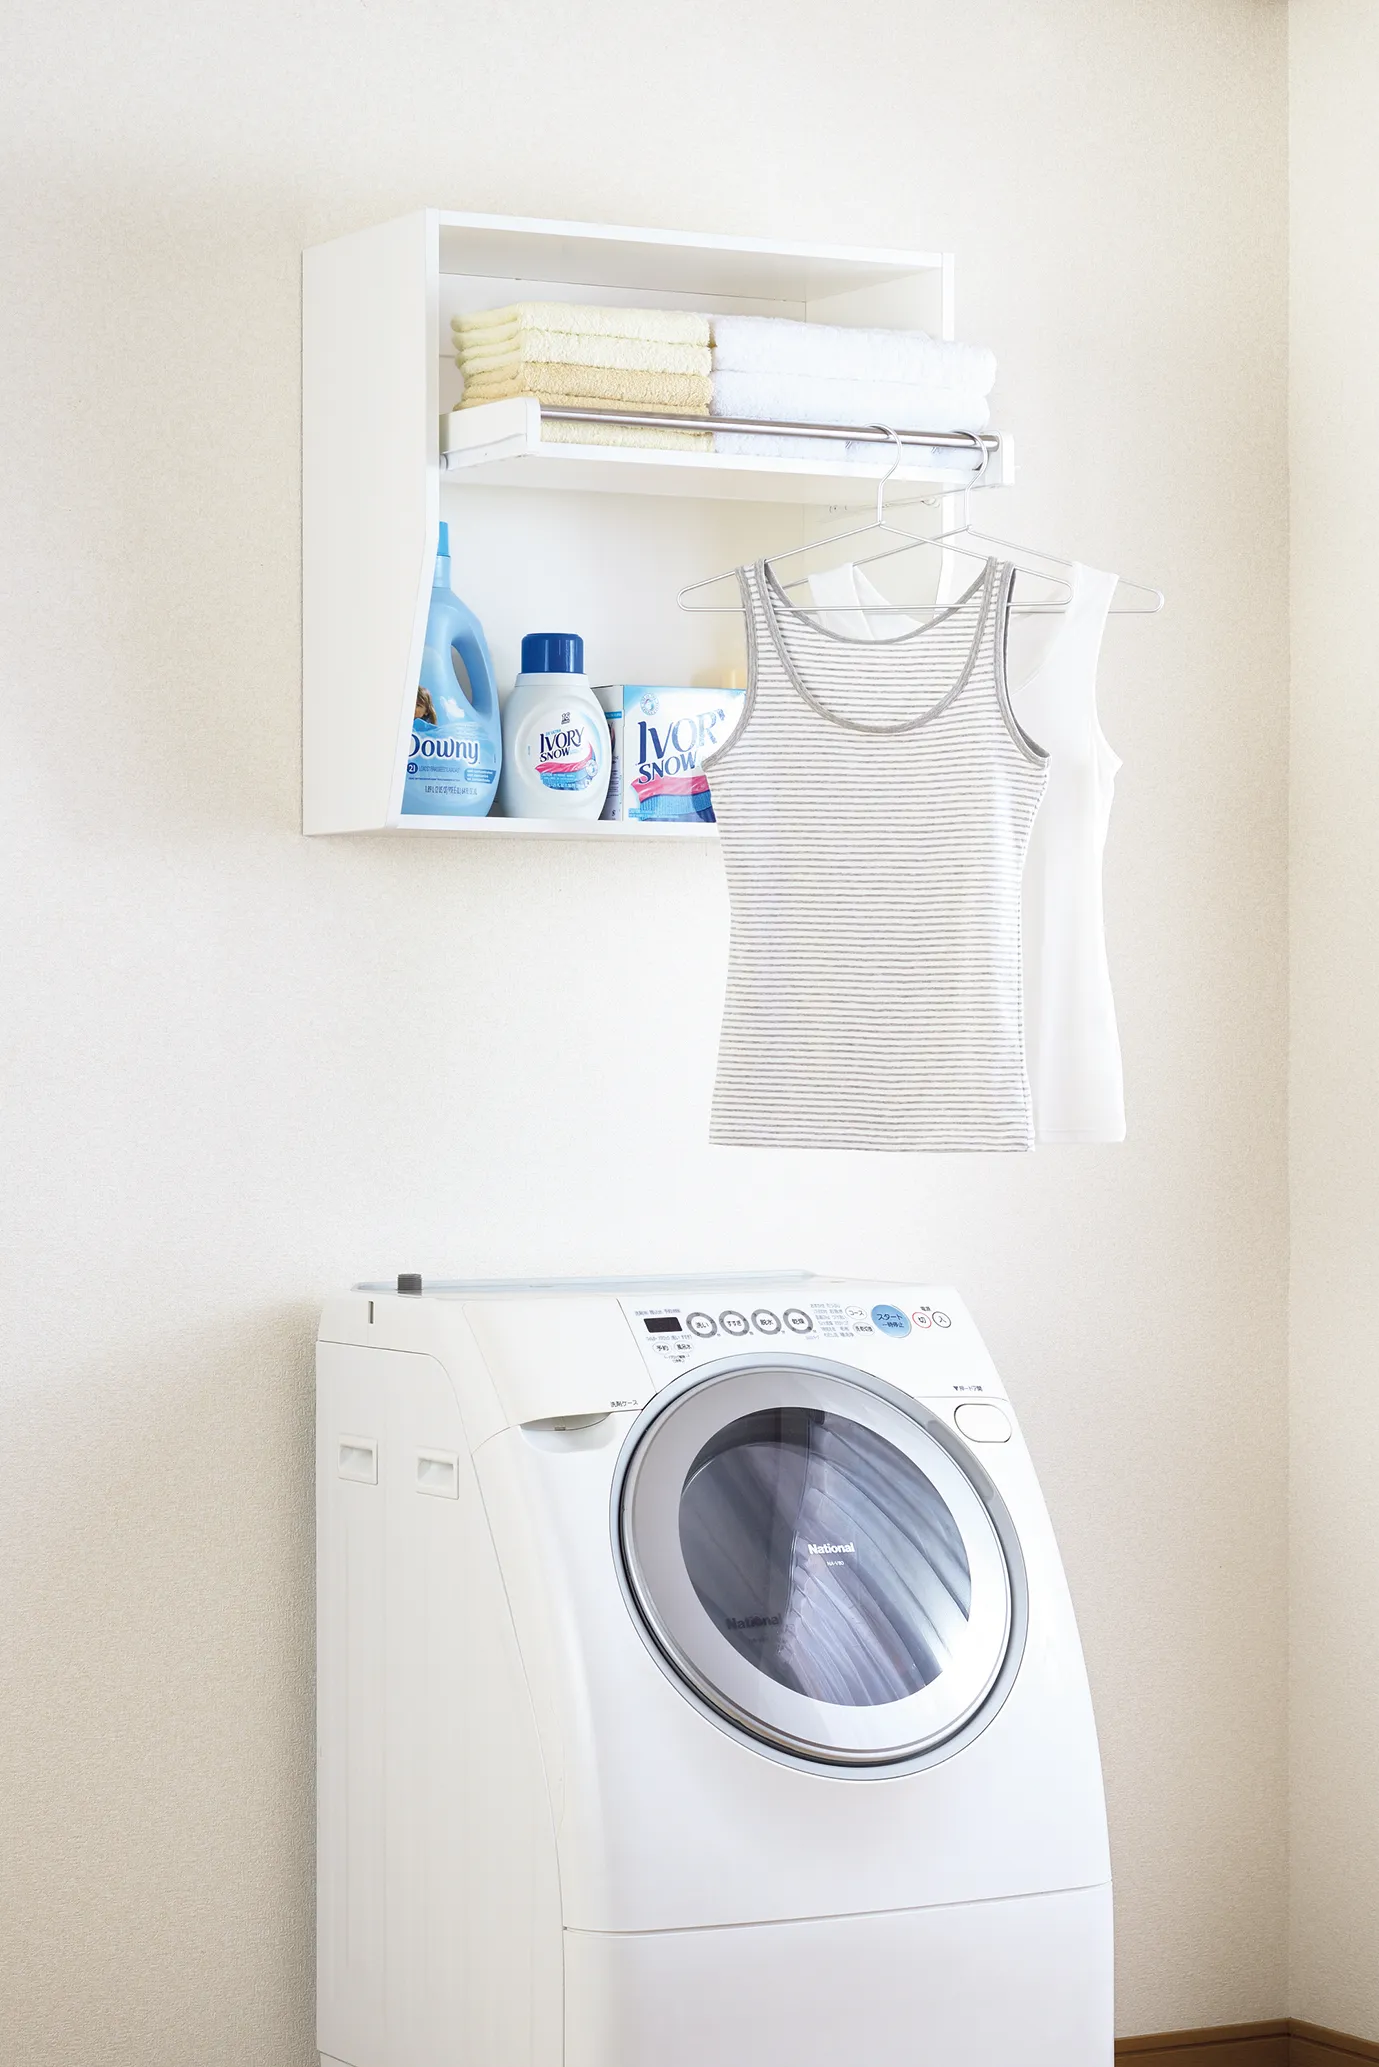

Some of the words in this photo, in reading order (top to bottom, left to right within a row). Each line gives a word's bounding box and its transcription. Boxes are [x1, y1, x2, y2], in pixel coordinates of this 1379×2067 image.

[540, 727, 584, 753] IVORY
[638, 709, 725, 765] IVOR
[540, 747, 570, 762] SNOW
[639, 752, 697, 784] SNOW
[759, 1318, 773, 1326] 脱水
[877, 1313, 903, 1321] スタート
[918, 1316, 927, 1324] 切
[938, 1315, 947, 1323] 入
[695, 1321, 710, 1329] 洗い
[807, 1542, 856, 1555] National
